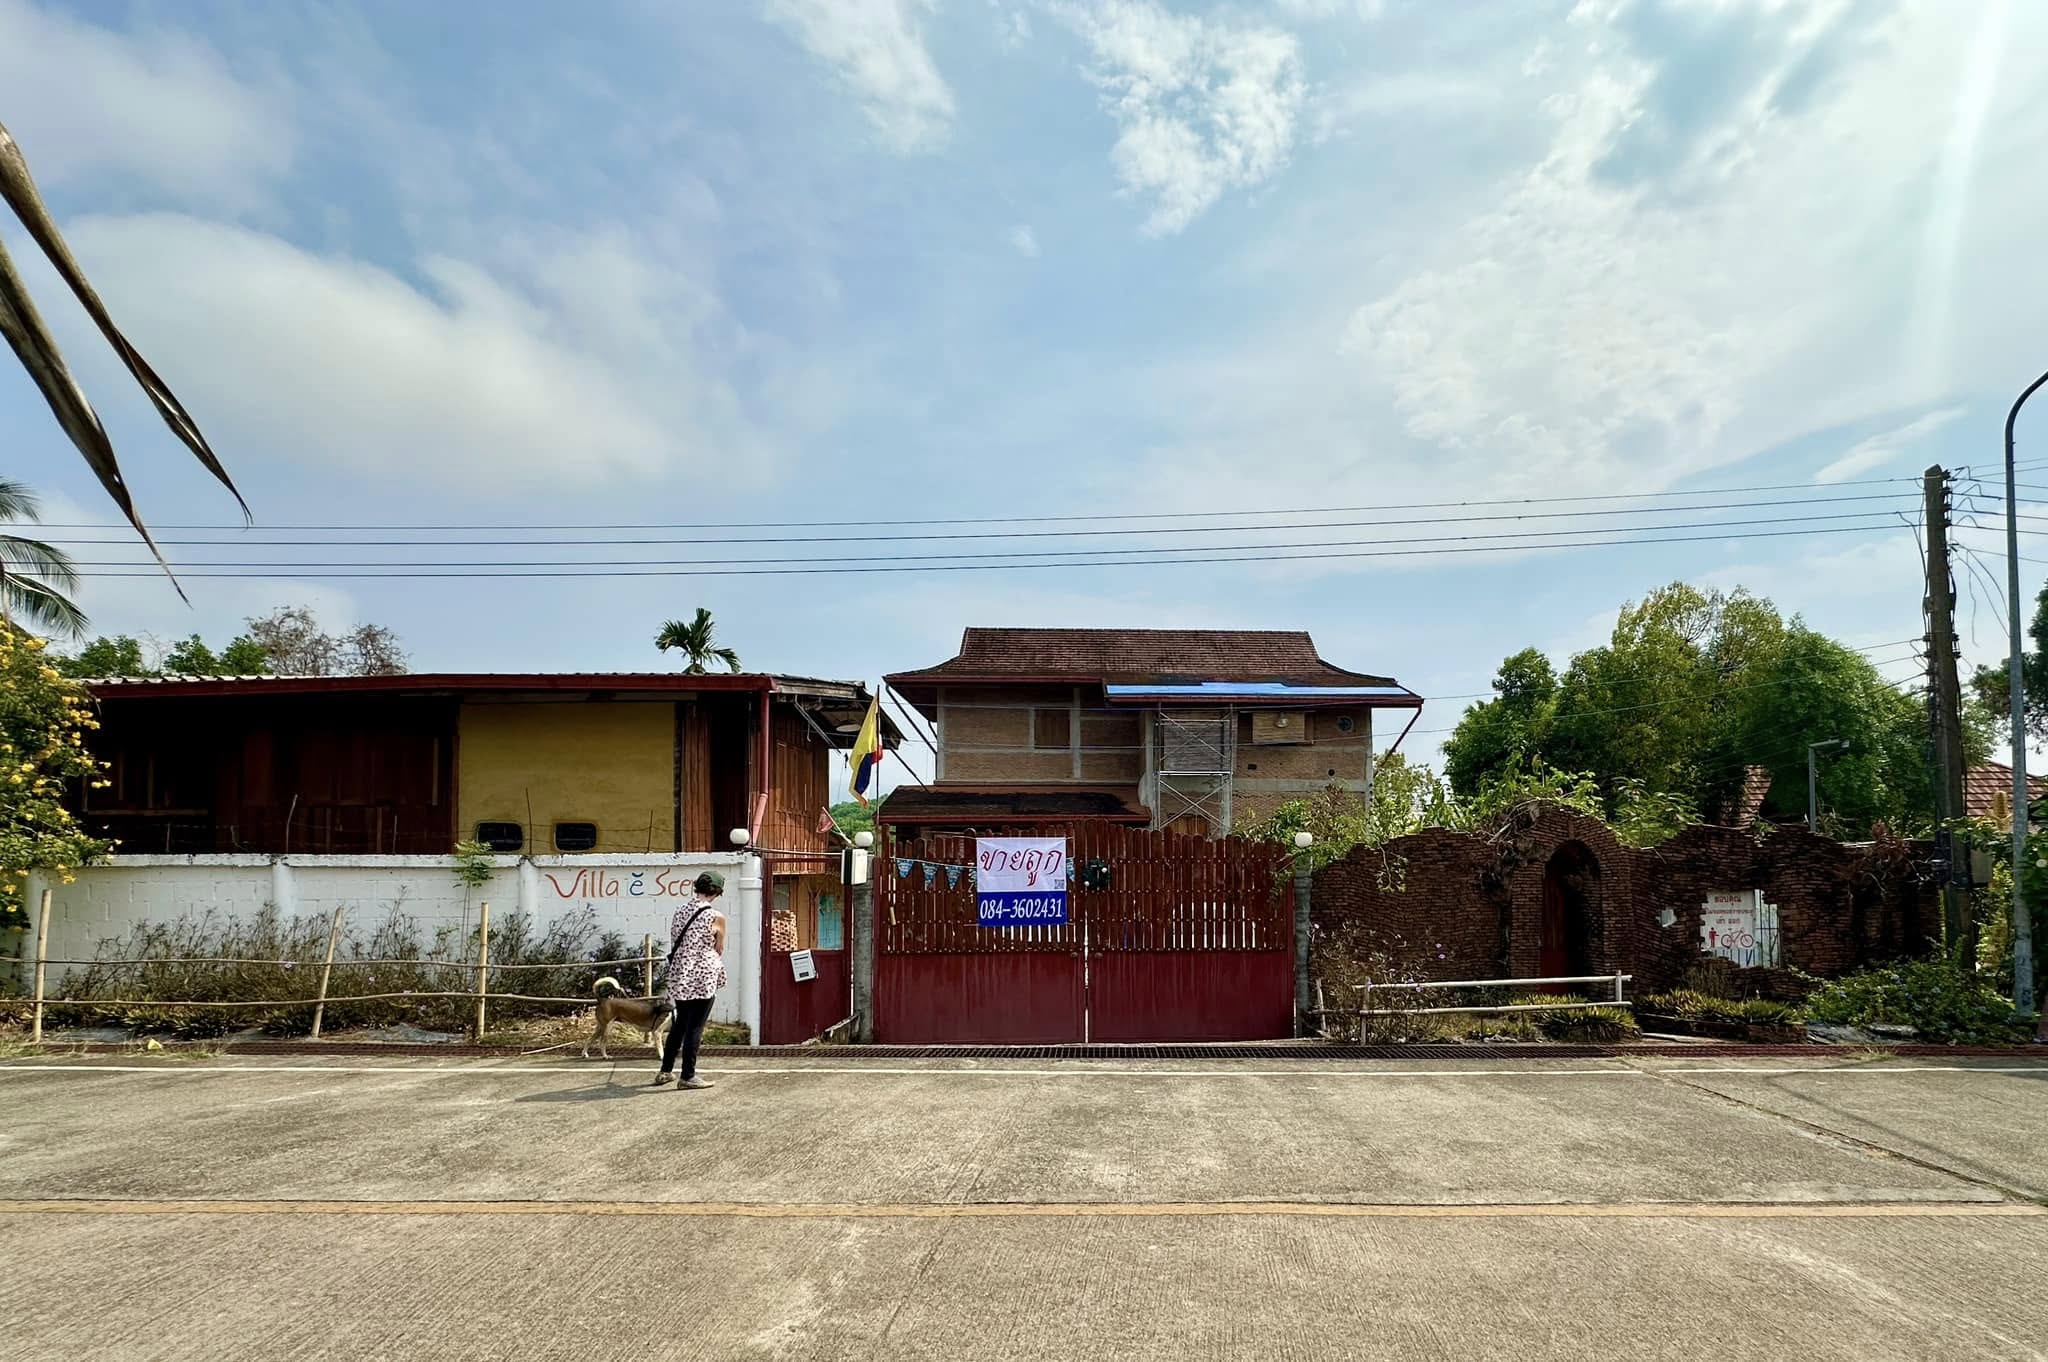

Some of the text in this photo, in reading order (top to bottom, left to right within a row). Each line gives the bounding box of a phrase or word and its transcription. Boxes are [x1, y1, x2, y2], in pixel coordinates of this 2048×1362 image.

[980, 848, 1063, 887] ขายถูก
[545, 868, 619, 898] Villa
[980, 898, 1063, 919] 084-3602431
